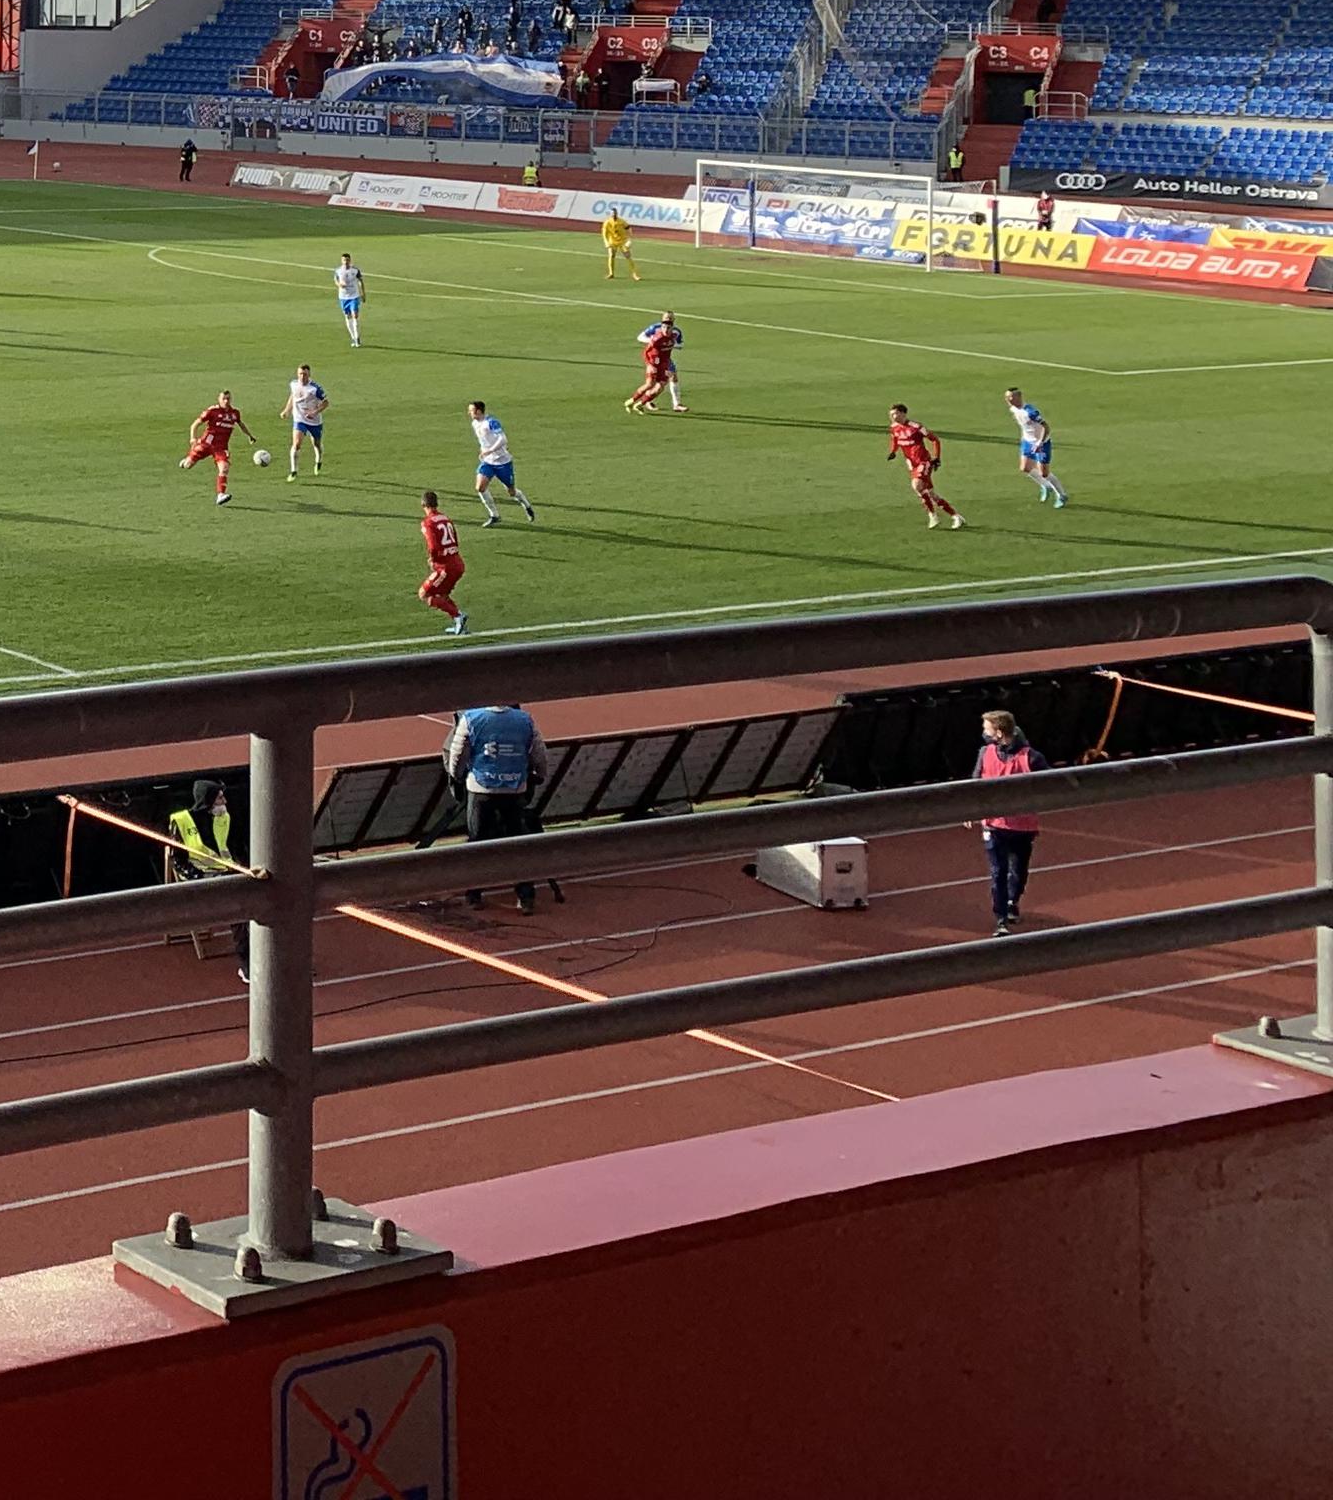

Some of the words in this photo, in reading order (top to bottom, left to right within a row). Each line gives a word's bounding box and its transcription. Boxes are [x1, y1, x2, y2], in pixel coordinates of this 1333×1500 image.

[309, 29, 322, 41] C1
[607, 37, 624, 49] C2
[641, 37, 658, 50] C3
[989, 46, 1007, 59] C3
[1029, 46, 1049, 60] C4
[318, 116, 379, 133] UNITED
[234, 166, 273, 185] PUMA
[290, 171, 333, 191] PUMA
[369, 185, 406, 195] HOCHTIEF
[431, 191, 470, 201] HOCHTIEF
[1133, 177, 1181, 192] Auto
[1184, 180, 1241, 197] Heller
[1245, 184, 1319, 201] Ostrava
[900, 225, 1079, 263] FORTUNA
[437, 522, 456, 546] 20
